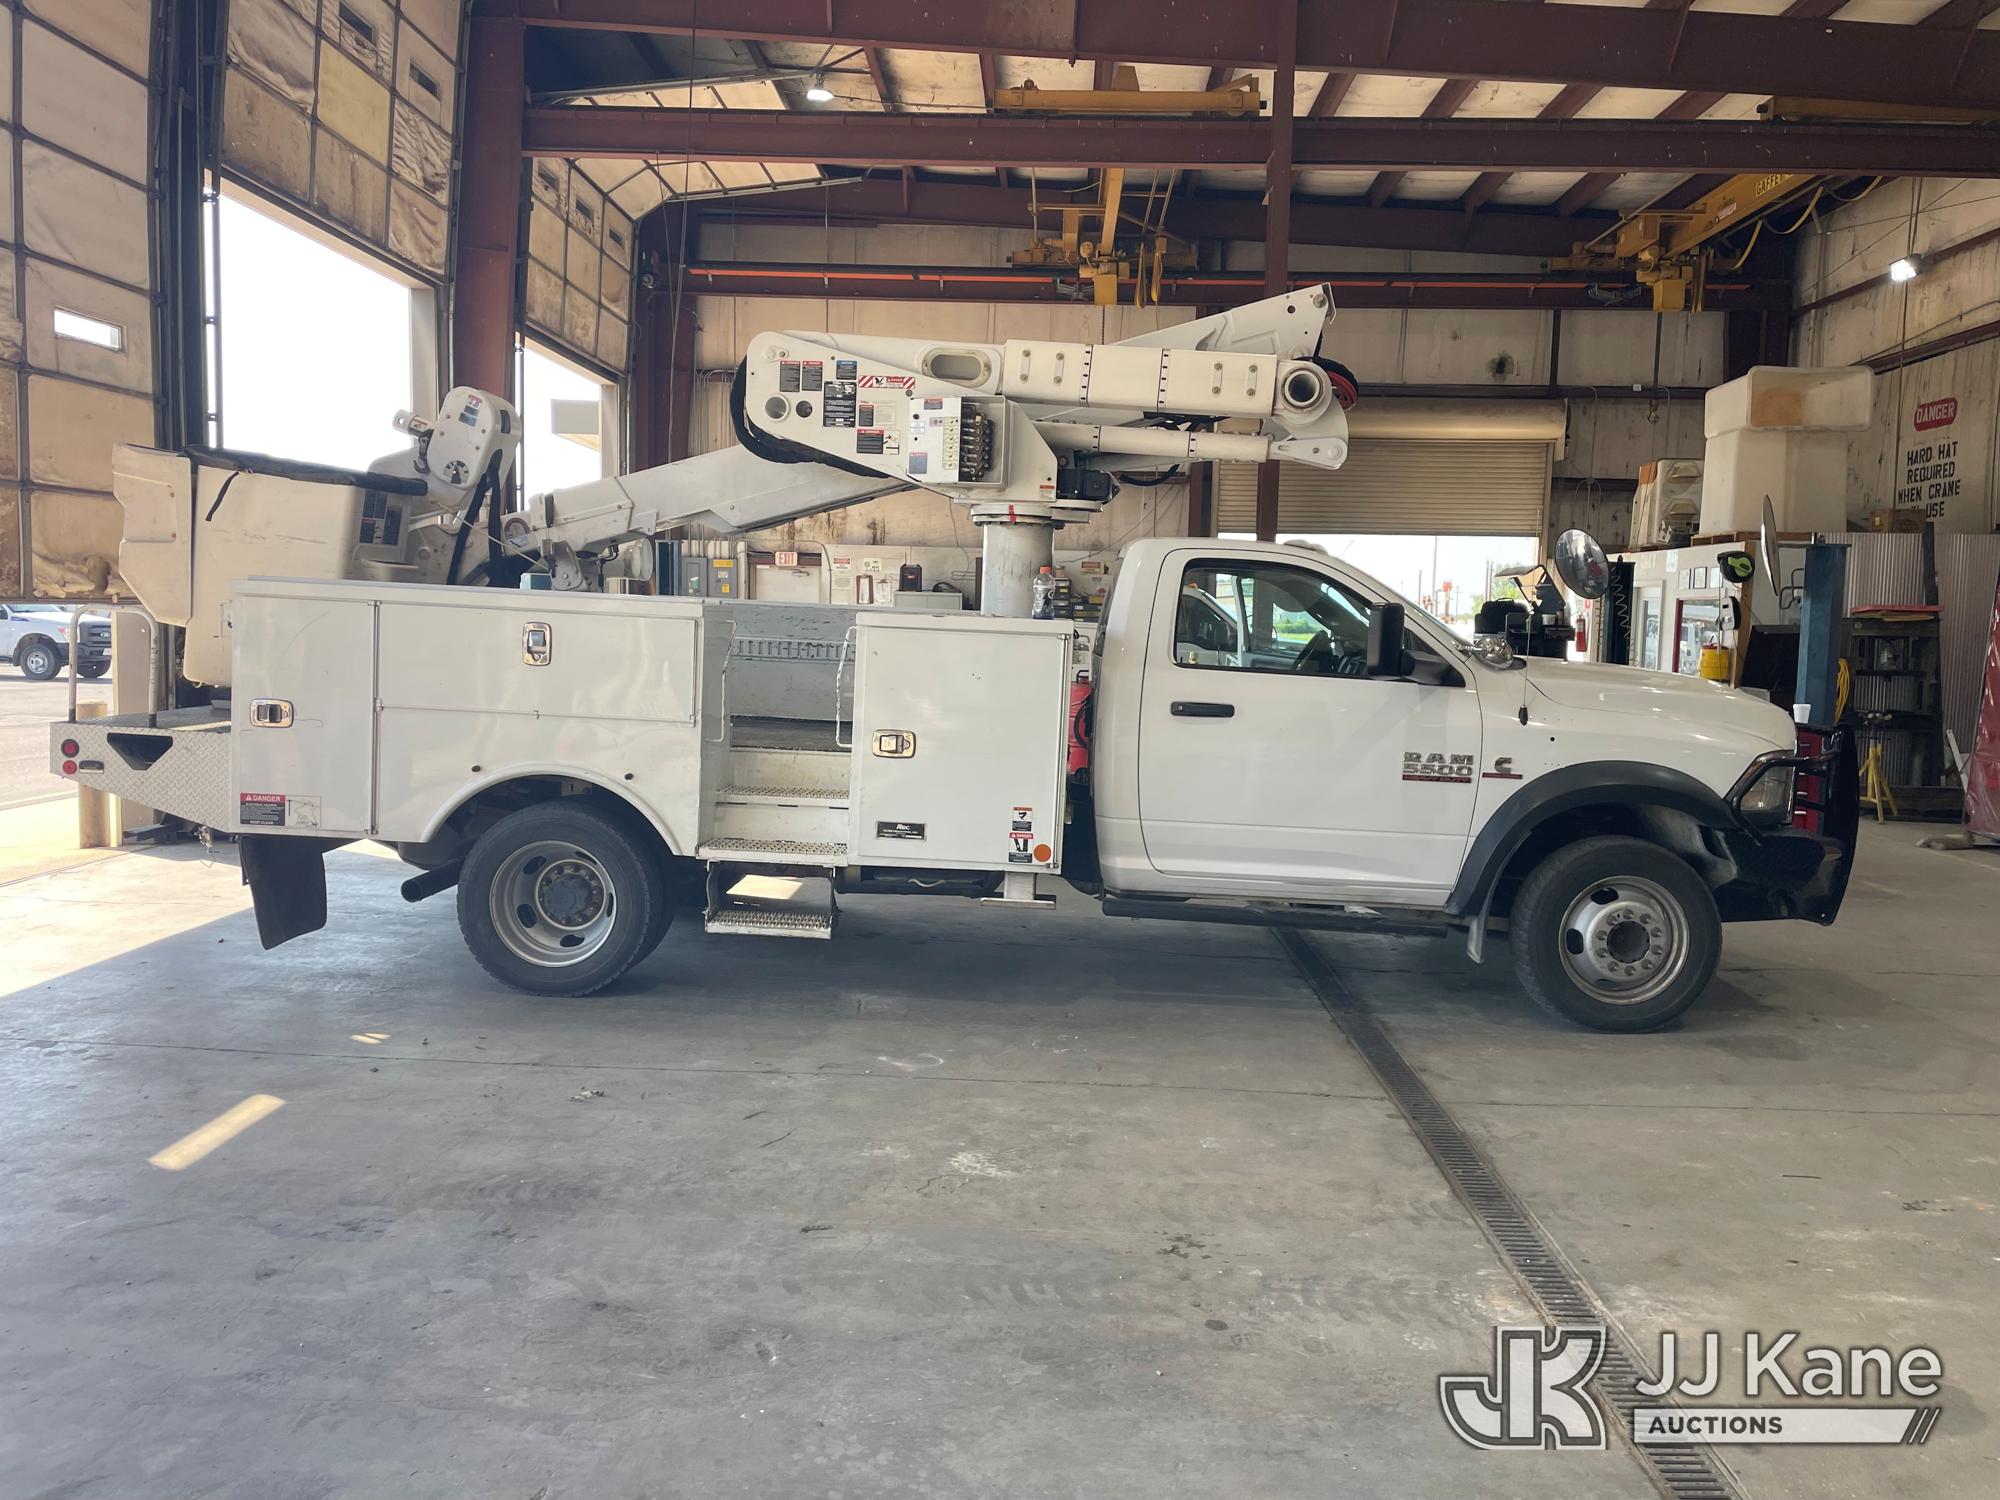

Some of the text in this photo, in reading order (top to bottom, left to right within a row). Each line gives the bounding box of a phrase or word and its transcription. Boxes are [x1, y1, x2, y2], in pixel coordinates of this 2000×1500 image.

[1916, 402, 1954, 424] DANGER
[1907, 441, 1958, 466] HARD HAT
[1907, 462, 1955, 484] REQUIRED
[1898, 480, 1960, 504] WHEN CRANE
[1925, 502, 1945, 518] USE
[779, 552, 796, 565] EXIT
[1404, 752, 1474, 766] RAM
[1403, 764, 1473, 776] 5500
